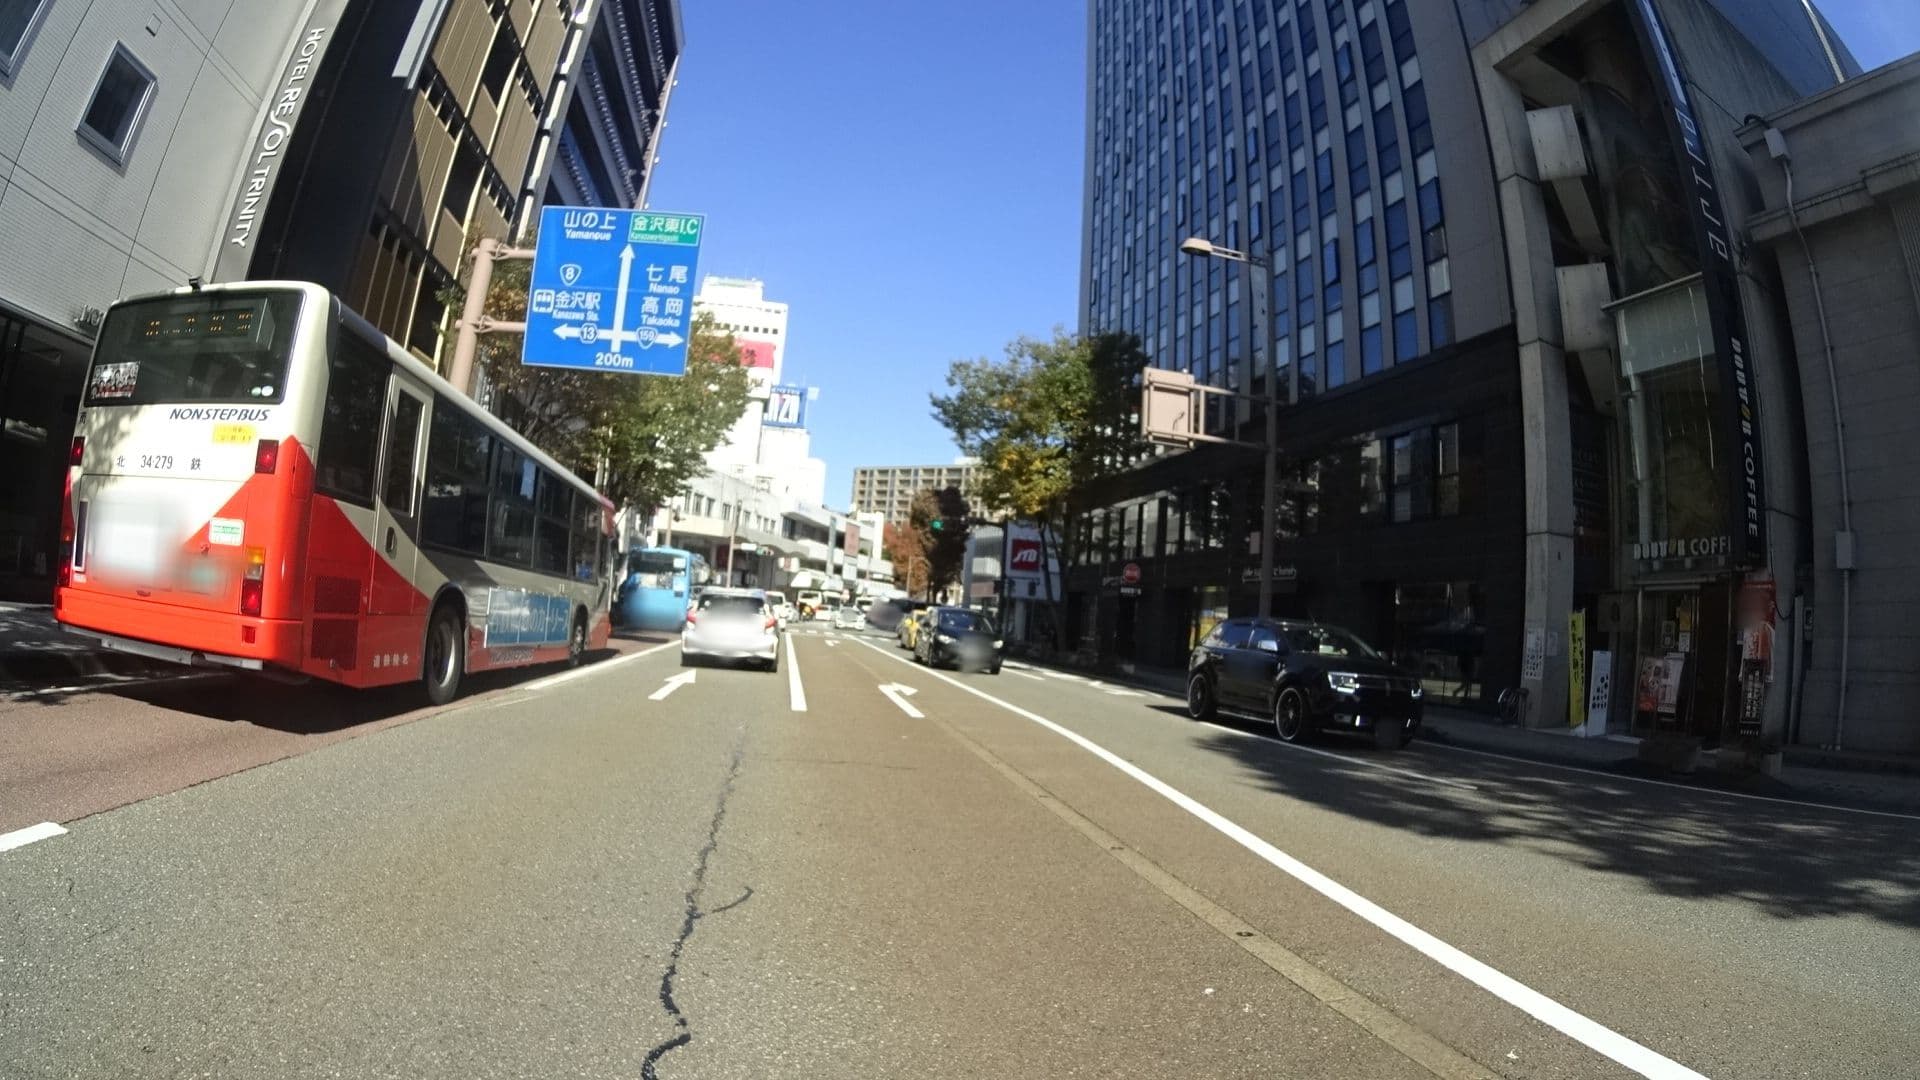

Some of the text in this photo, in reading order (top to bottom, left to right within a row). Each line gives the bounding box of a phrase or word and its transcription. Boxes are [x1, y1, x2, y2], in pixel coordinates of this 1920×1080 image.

[231, 27, 326, 248] HOTEL RESOL TRINITY
[563, 211, 617, 230] 山の上
[646, 264, 688, 284] 七尾
[649, 283, 680, 295] Nanao
[554, 291, 601, 310] 金沢駅
[641, 296, 684, 316] 高岡
[641, 314, 681, 327] Takaoka
[582, 328, 595, 340] 13
[638, 329, 654, 342] 159
[595, 352, 634, 368] 200m
[1744, 441, 1759, 537] COFFEE
[1690, 535, 1731, 556] COFF
